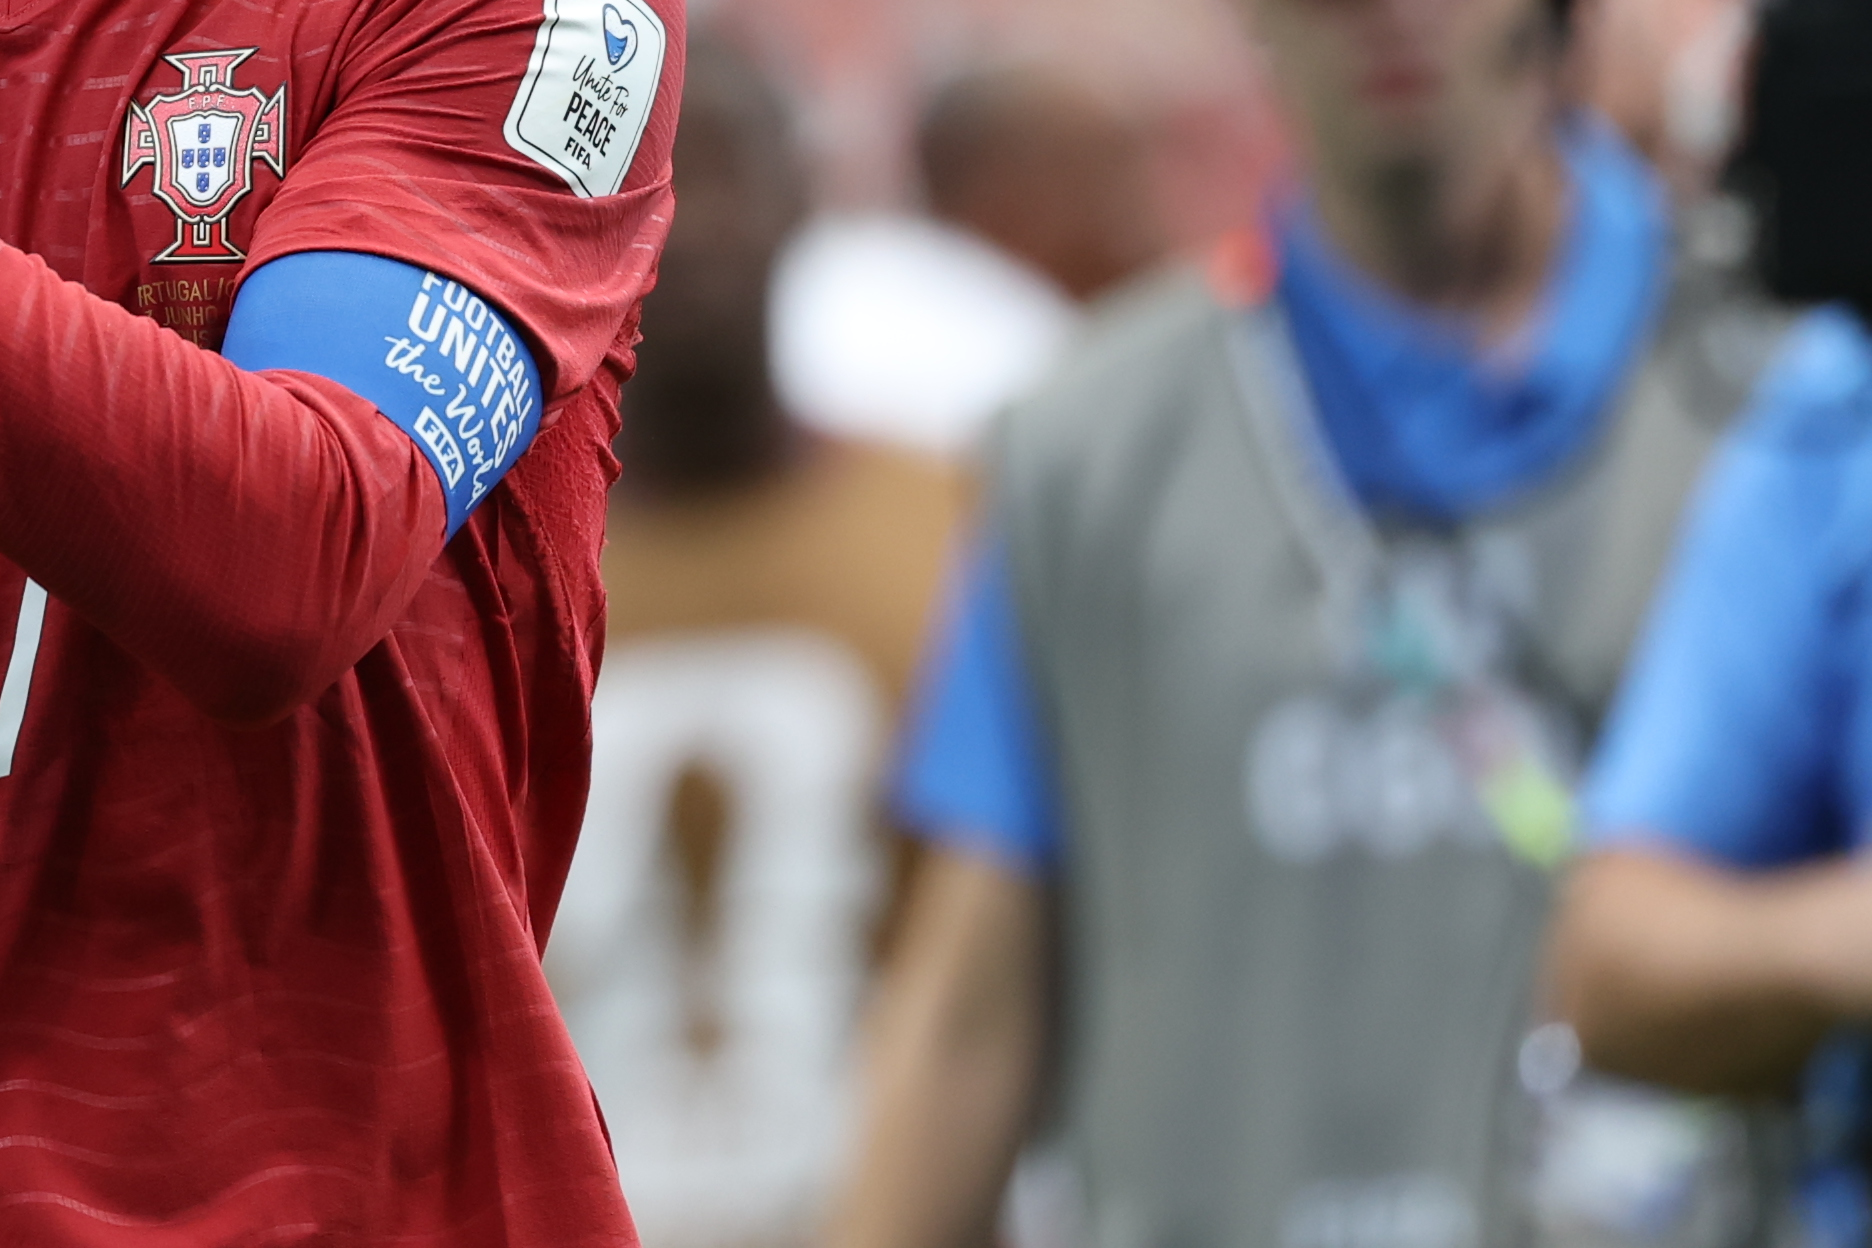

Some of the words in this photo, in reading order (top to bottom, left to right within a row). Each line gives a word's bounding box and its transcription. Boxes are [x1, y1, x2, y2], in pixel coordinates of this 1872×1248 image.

[572, 54, 613, 102] Unite
[609, 84, 630, 117] For
[563, 91, 616, 157] PEACE
[564, 137, 591, 170] FIFA
[162, 304, 218, 326] JUNHO
[408, 291, 519, 469] UNITES
[421, 271, 534, 436] FOOTBALL
[384, 335, 447, 396] the
[445, 382, 495, 511] World
[419, 413, 461, 485] FIFA
